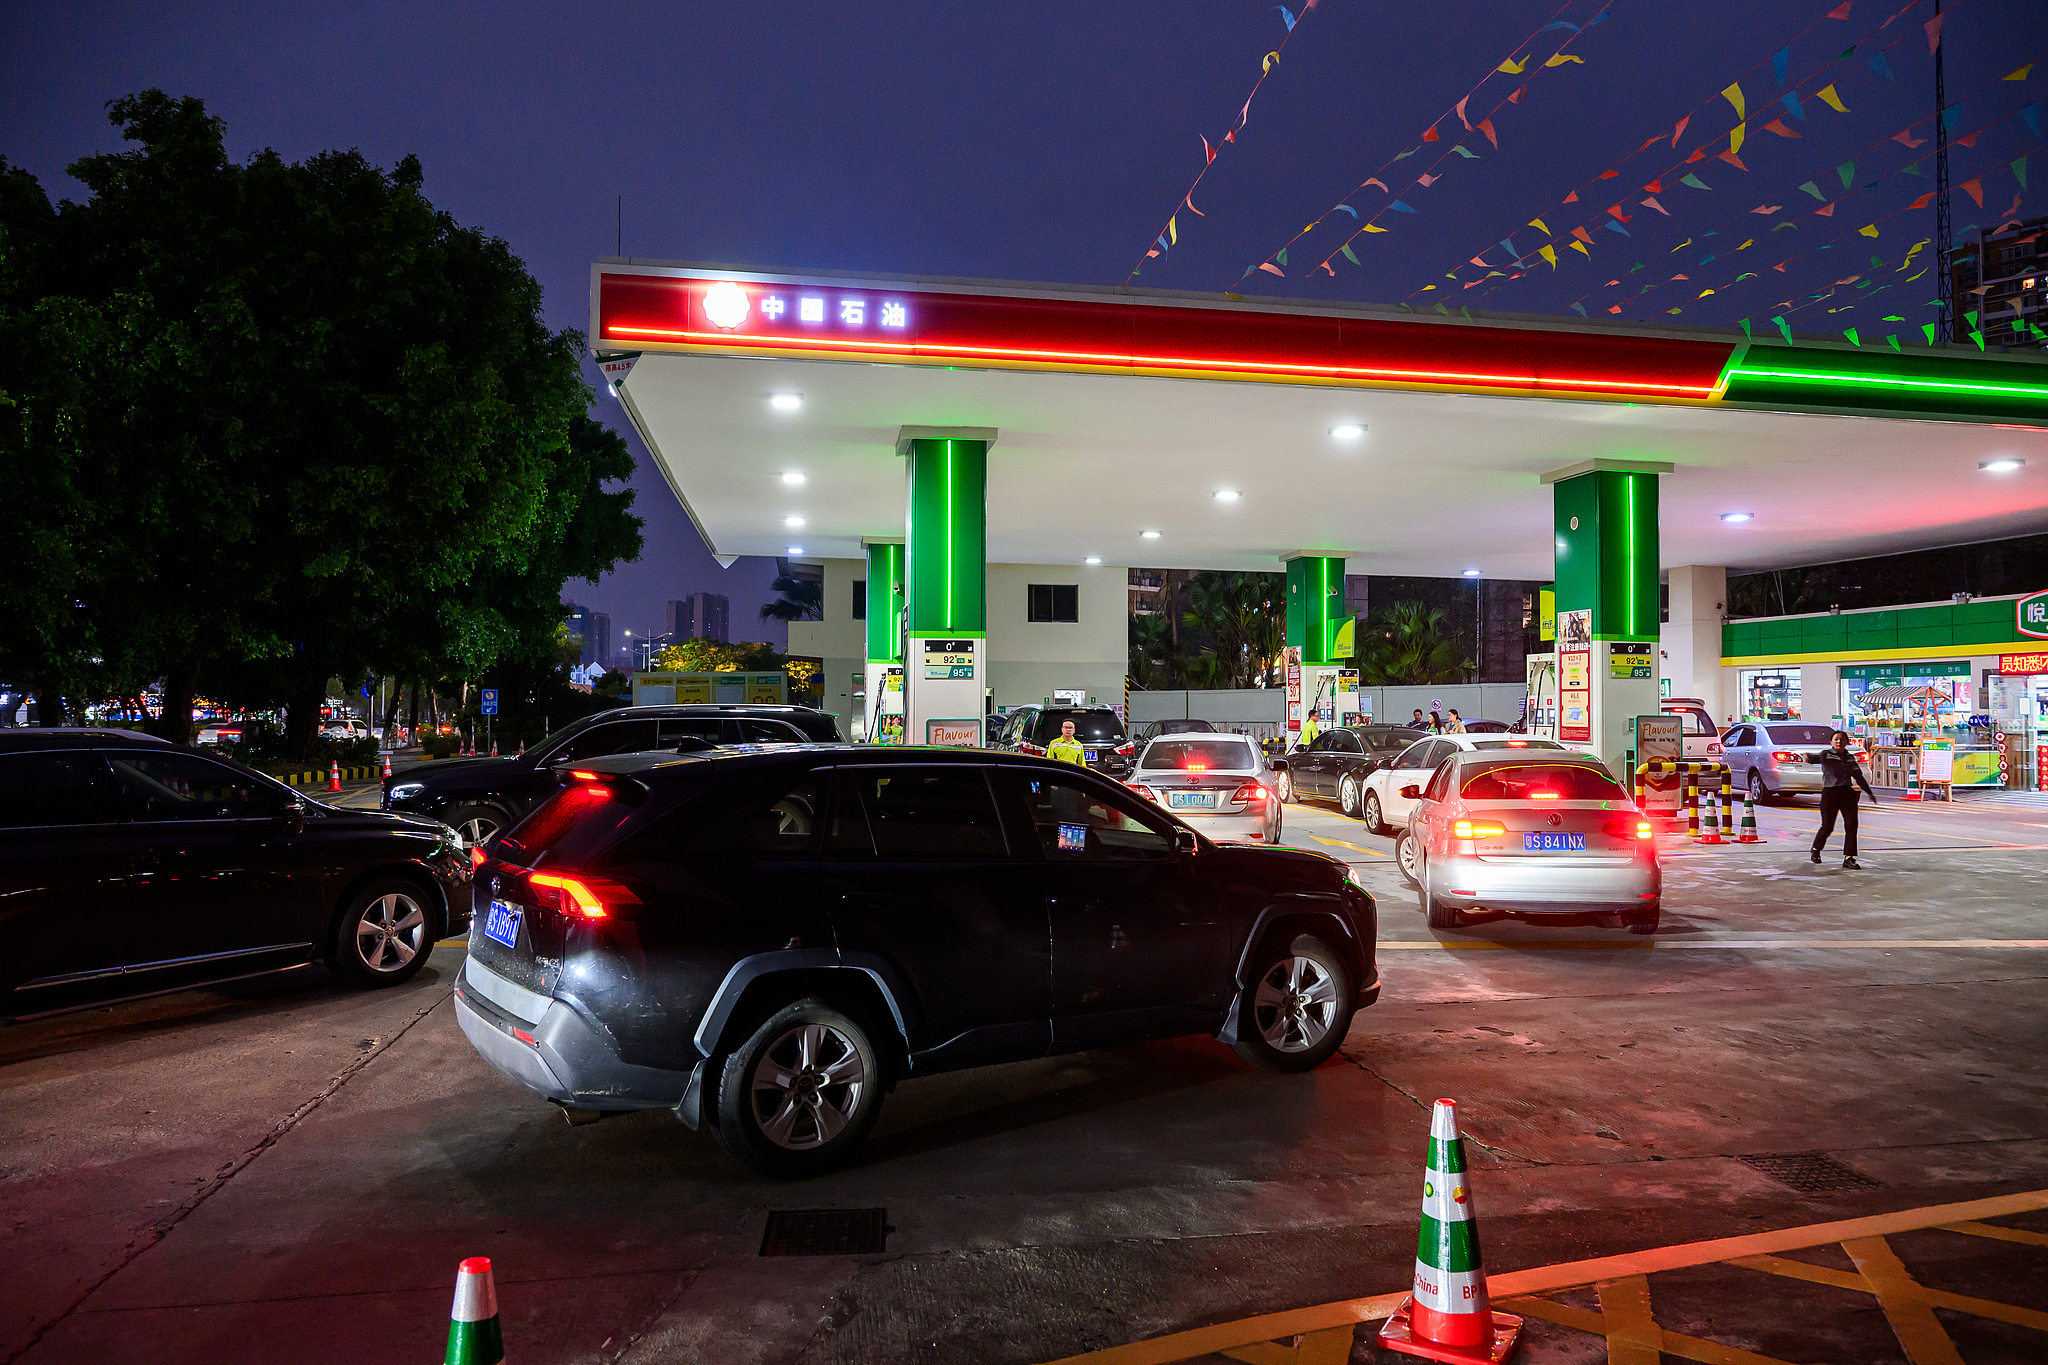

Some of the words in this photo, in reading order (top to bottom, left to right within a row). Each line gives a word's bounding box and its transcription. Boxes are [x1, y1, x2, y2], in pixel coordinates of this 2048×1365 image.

[761, 295, 906, 327] 中国石油
[934, 727, 975, 745] Flavour
[1642, 723, 1677, 738] Flavour
[1463, 1284, 1478, 1300] BP
